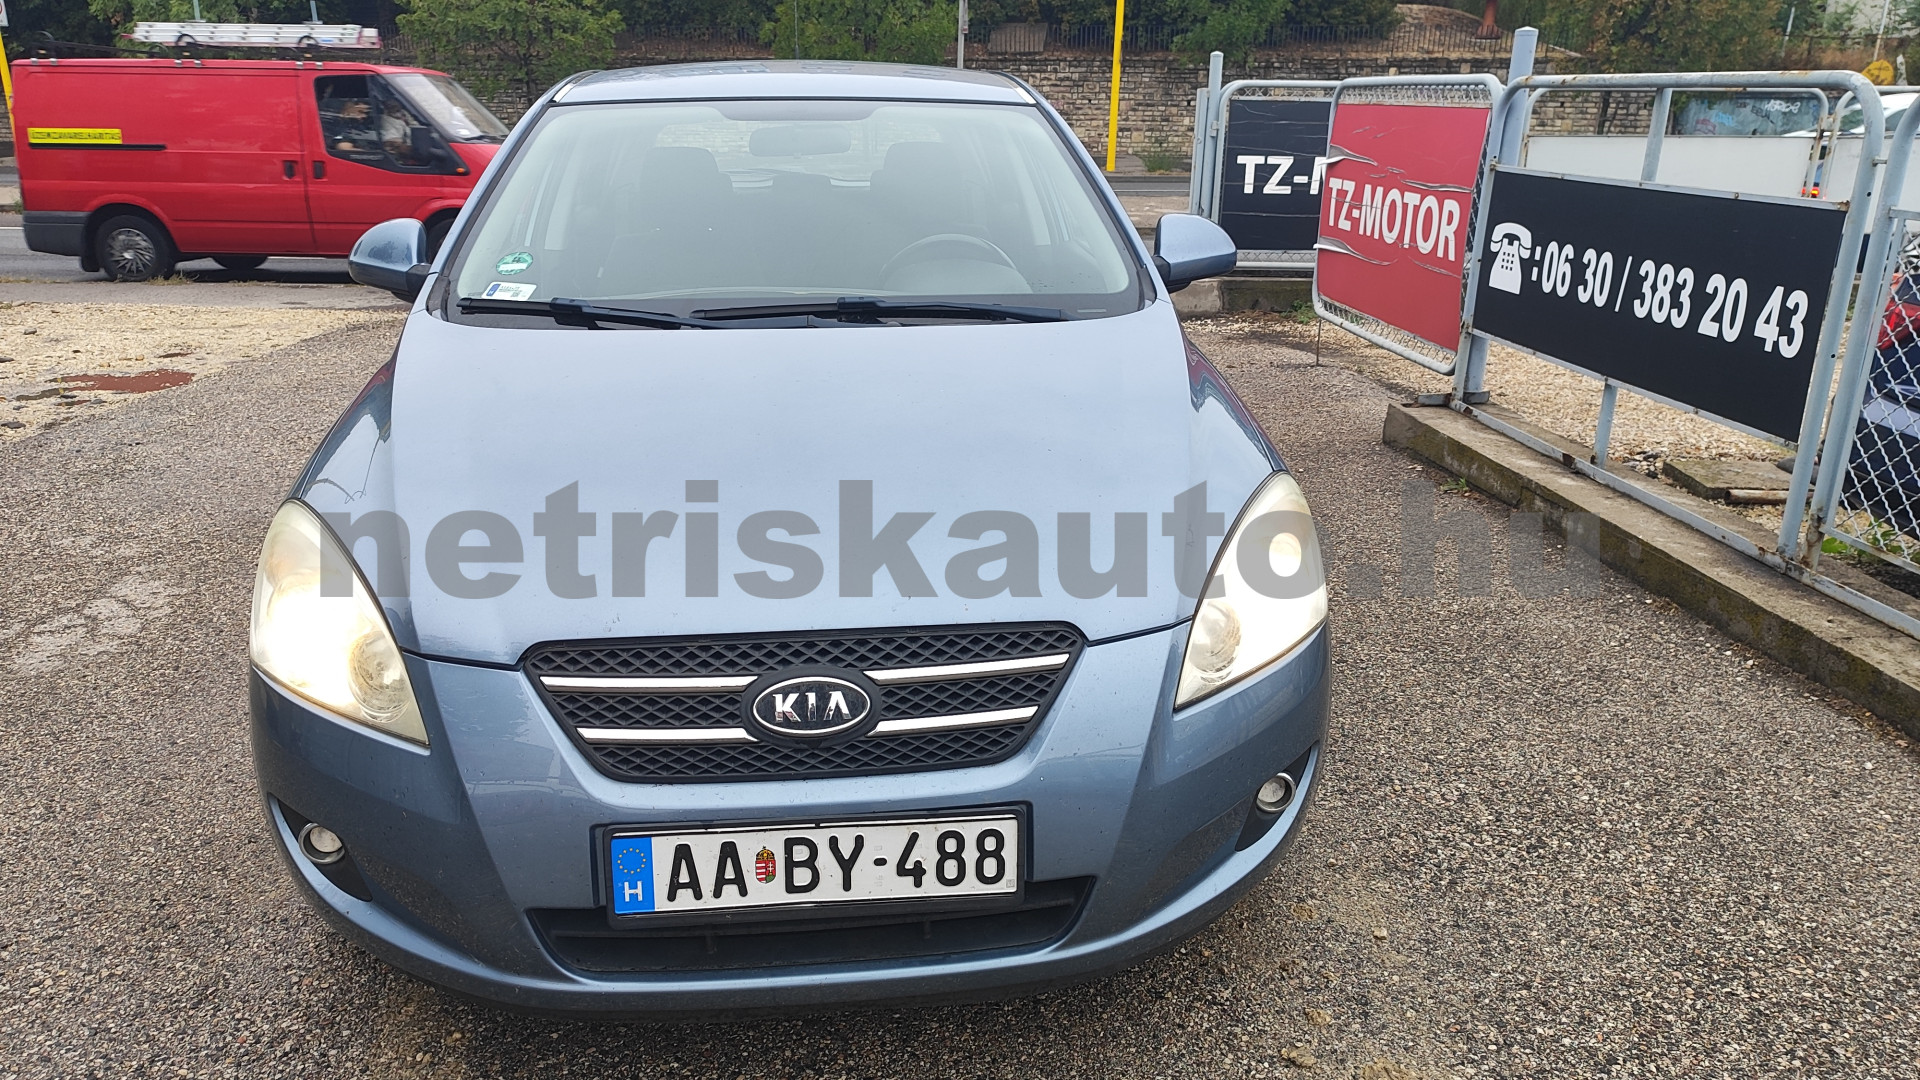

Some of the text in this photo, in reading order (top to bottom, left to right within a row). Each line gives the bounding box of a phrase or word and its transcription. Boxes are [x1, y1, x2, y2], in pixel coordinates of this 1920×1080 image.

[1328, 177, 1461, 262] TZ-MOTOR
[1577, 248, 1613, 307] 30
[1633, 259, 1695, 328] 383
[1697, 273, 1748, 342] 20
[1754, 285, 1808, 358] 43
[772, 691, 852, 722] KIA
[624, 881, 643, 902] H
